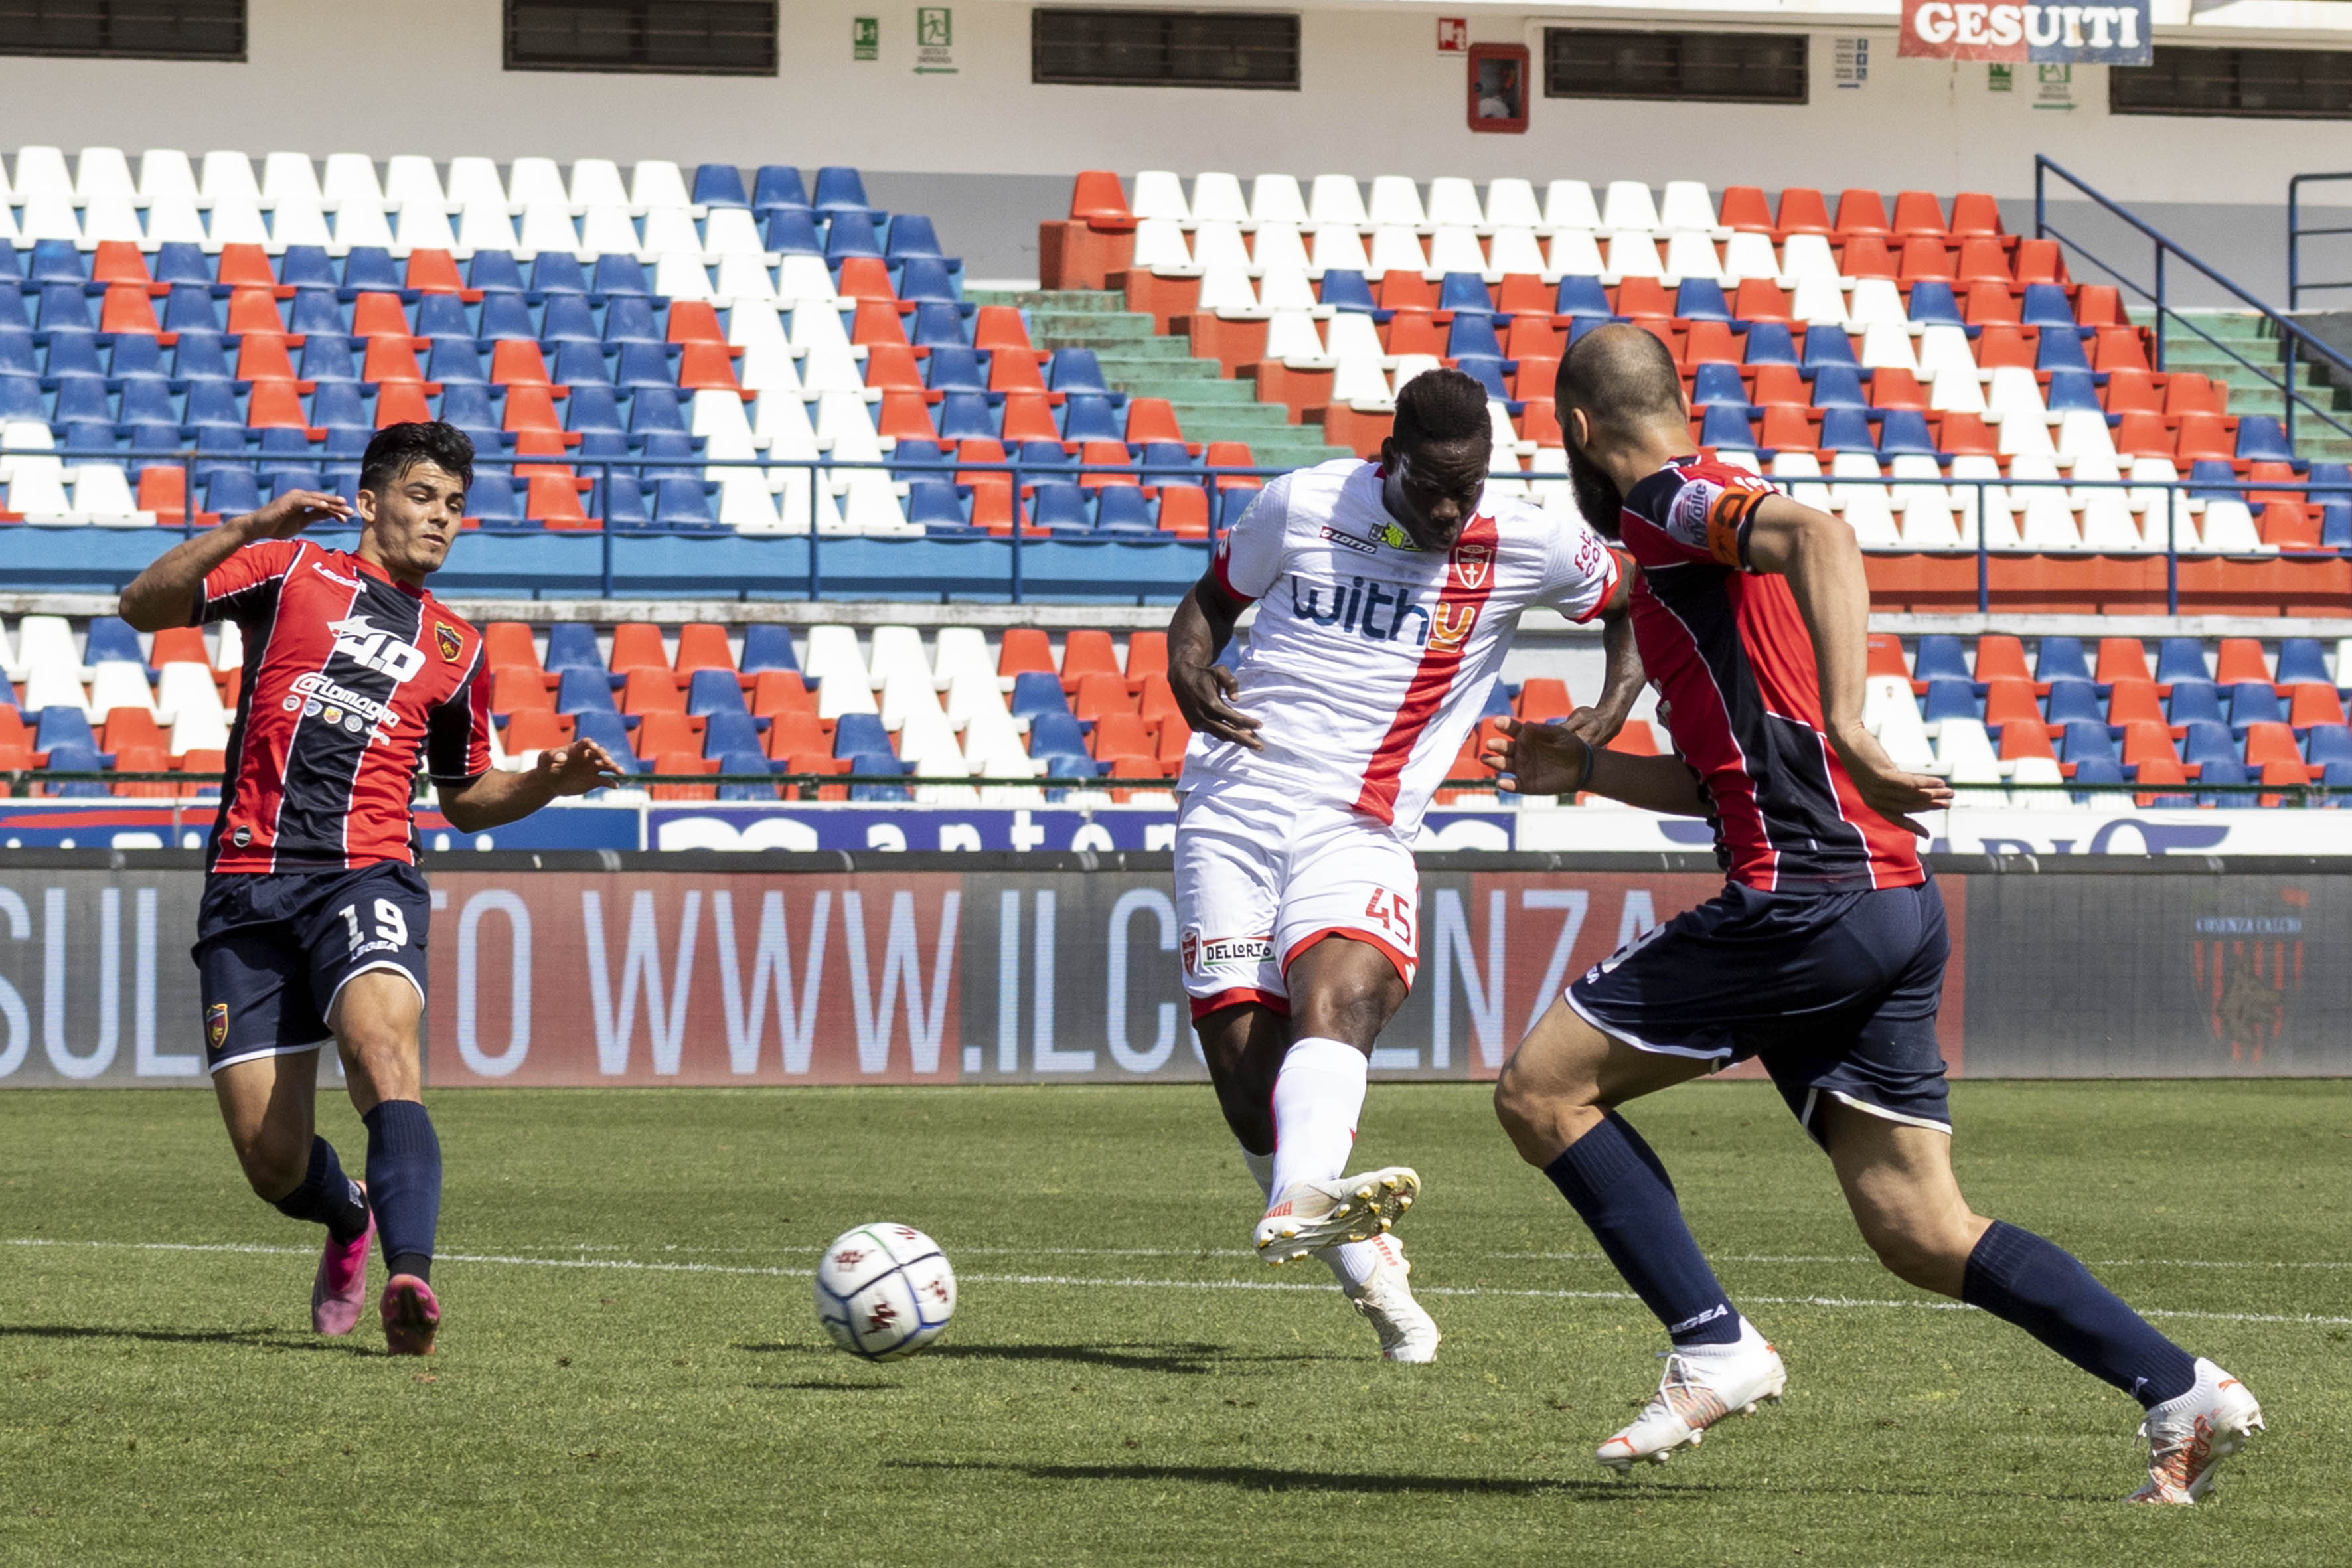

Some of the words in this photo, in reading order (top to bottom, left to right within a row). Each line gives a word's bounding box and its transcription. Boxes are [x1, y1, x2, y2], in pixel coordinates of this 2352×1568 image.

[1915, 3, 2140, 48] GESUITI
[1332, 532, 1377, 554] LOTTO
[339, 898, 408, 953] 19
[1366, 887, 1411, 947] 45
[350, 940, 399, 963] LEGEA
